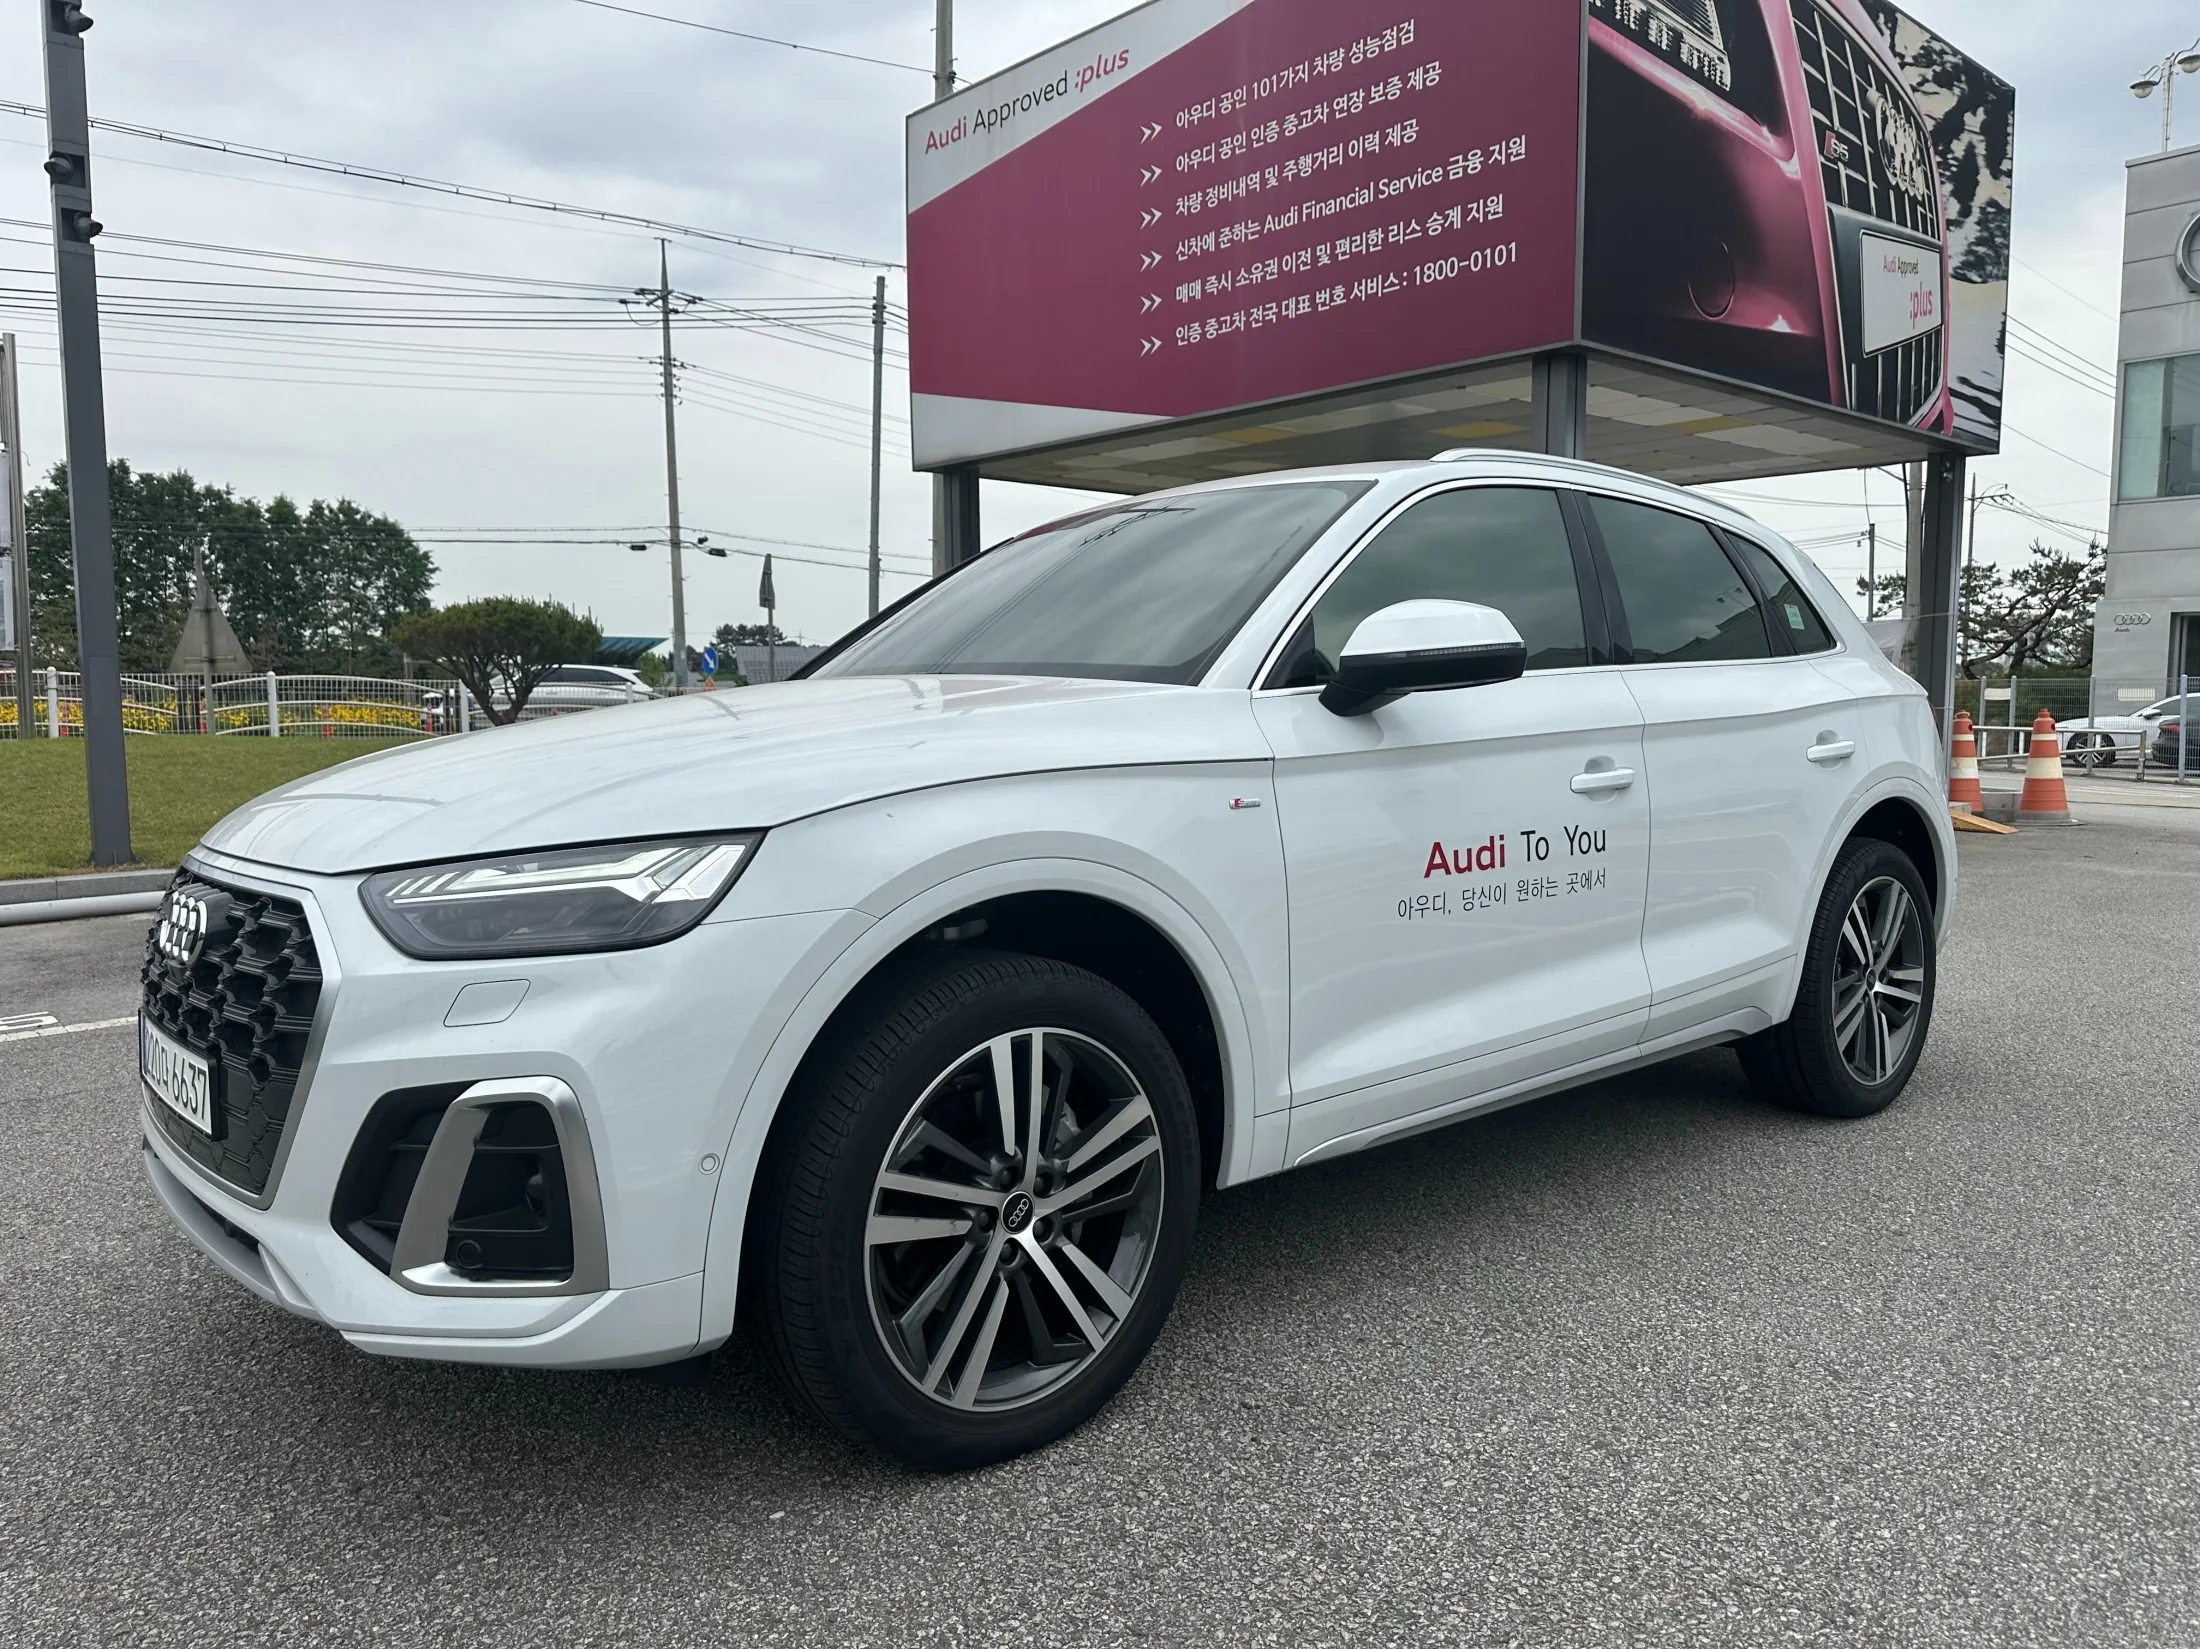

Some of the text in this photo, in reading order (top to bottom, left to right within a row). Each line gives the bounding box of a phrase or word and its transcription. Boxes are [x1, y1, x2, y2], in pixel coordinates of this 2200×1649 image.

[925, 48, 1130, 155] Audi Approved :plus
[1176, 18, 1415, 130] 아우디 공인 101가지 차량 성능점검
[1176, 61, 1442, 173] 아우디 공인 인증 중고차 연장 보증 제공
[1175, 118, 1420, 217] 차량 정비내역 및 주행거리 이력 제공
[1175, 134, 1526, 262] 신차에 준하는 Audi Financial Service 금융 지원
[1175, 193, 1503, 303] 매매 즉시 소유권 이전 및 편리한 리스 승계 지원
[1175, 322, 1202, 347] 인증
[1204, 310, 1247, 340] 중고차
[1249, 302, 1279, 329] 전국
[1281, 294, 1312, 319] 대표
[1315, 284, 1347, 312] 번호
[1413, 241, 1517, 286] 1800-0101
[1883, 255, 1896, 273] Audi
[1397, 867, 1606, 920] 아우디, 당신이 원하는 곳에서
[1423, 824, 1606, 879] Audi To You
[172, 1051, 207, 1120] 6637
